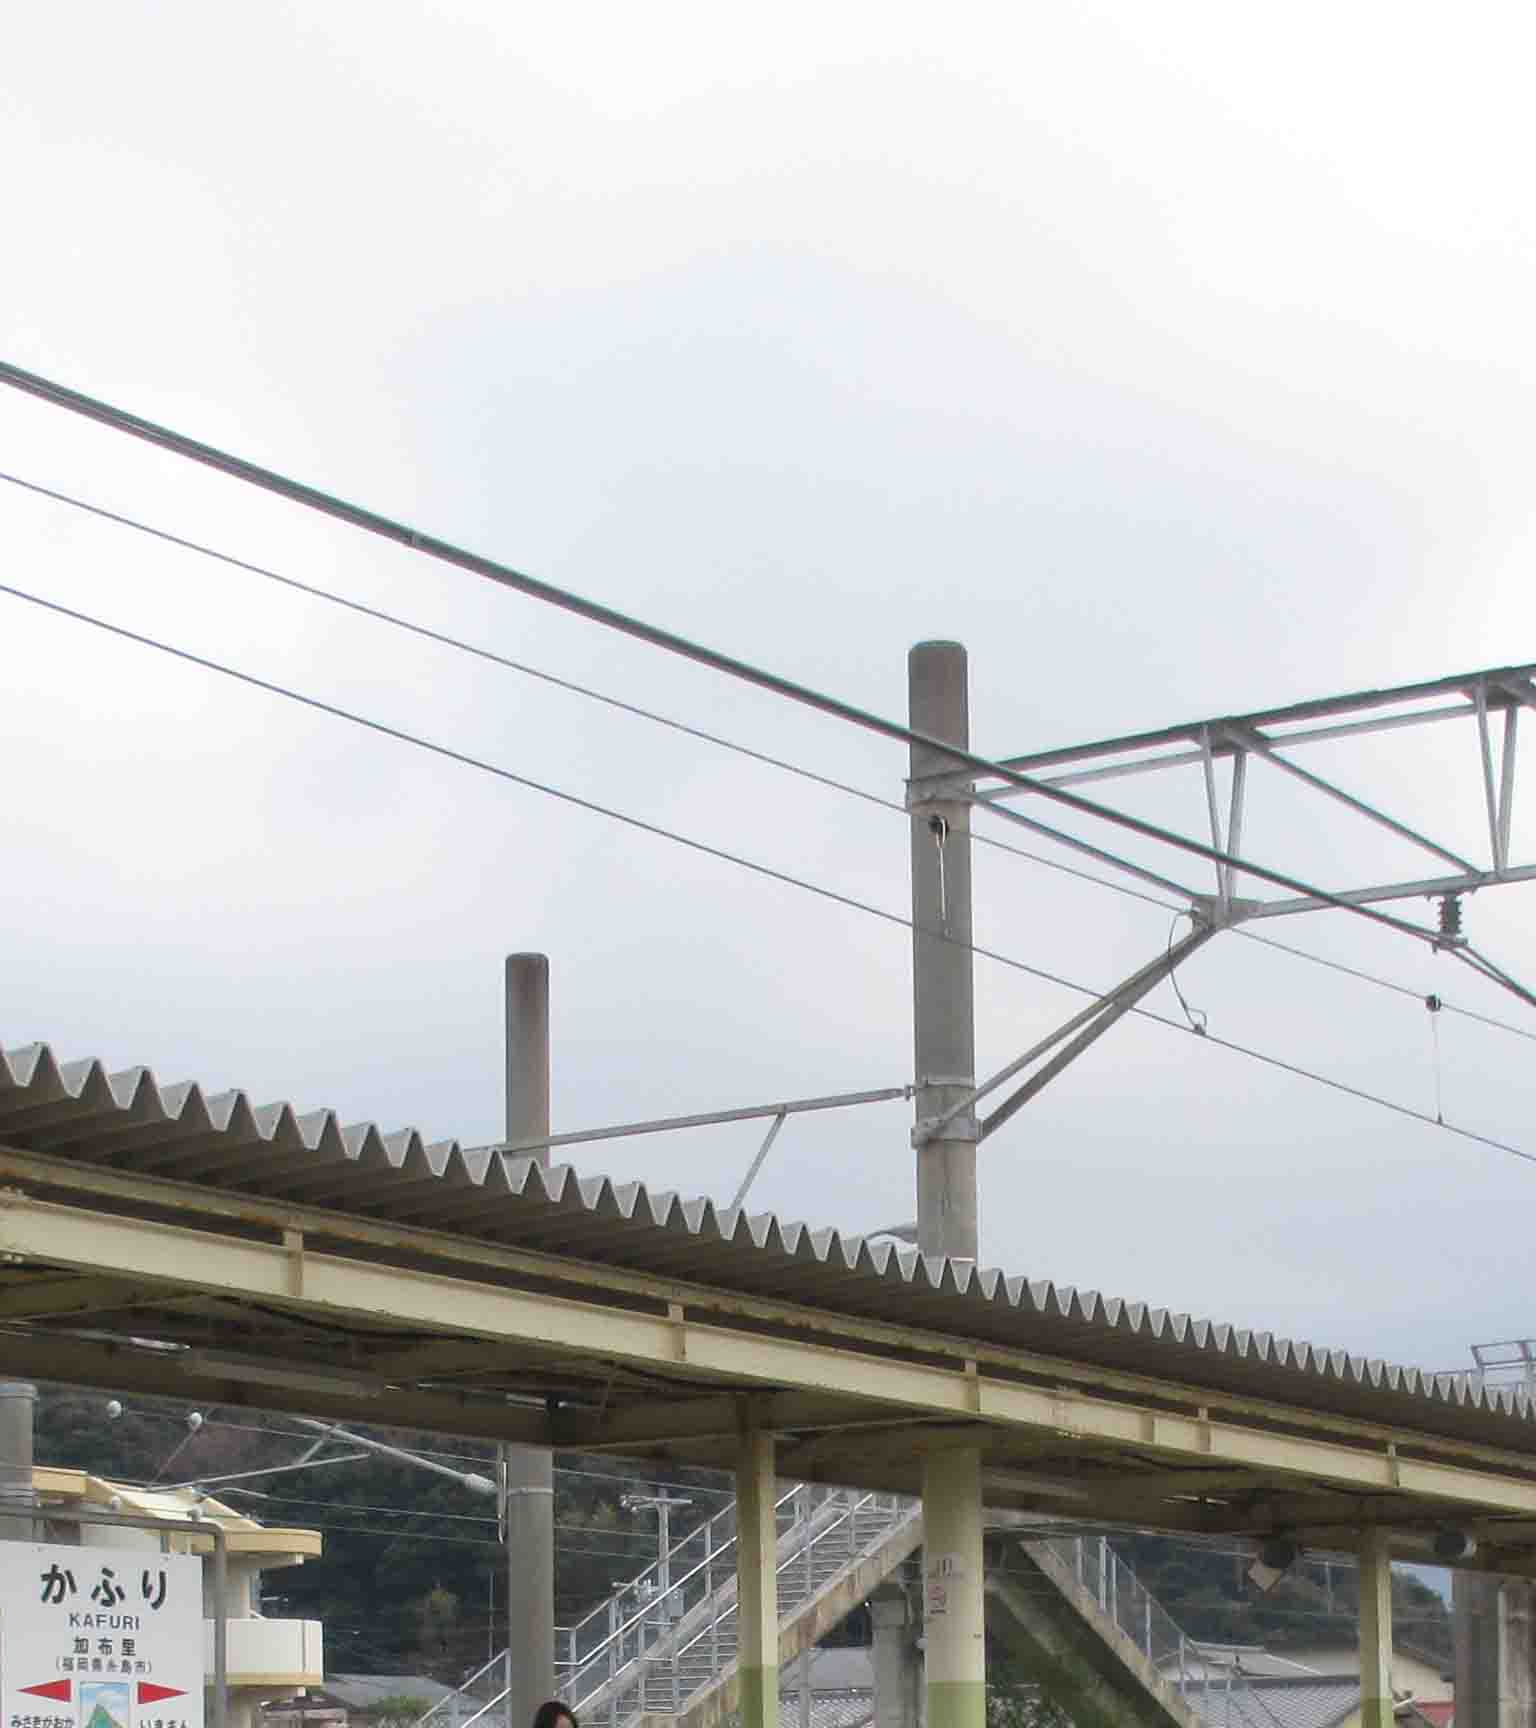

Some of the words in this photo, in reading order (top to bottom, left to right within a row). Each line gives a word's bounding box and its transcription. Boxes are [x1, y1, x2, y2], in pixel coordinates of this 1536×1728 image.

[41, 1564, 166, 1610] かふり
[69, 1613, 140, 1630] KAFURI
[73, 1636, 136, 1656] 加布里
[11, 1715, 74, 1728] みさきがおか
